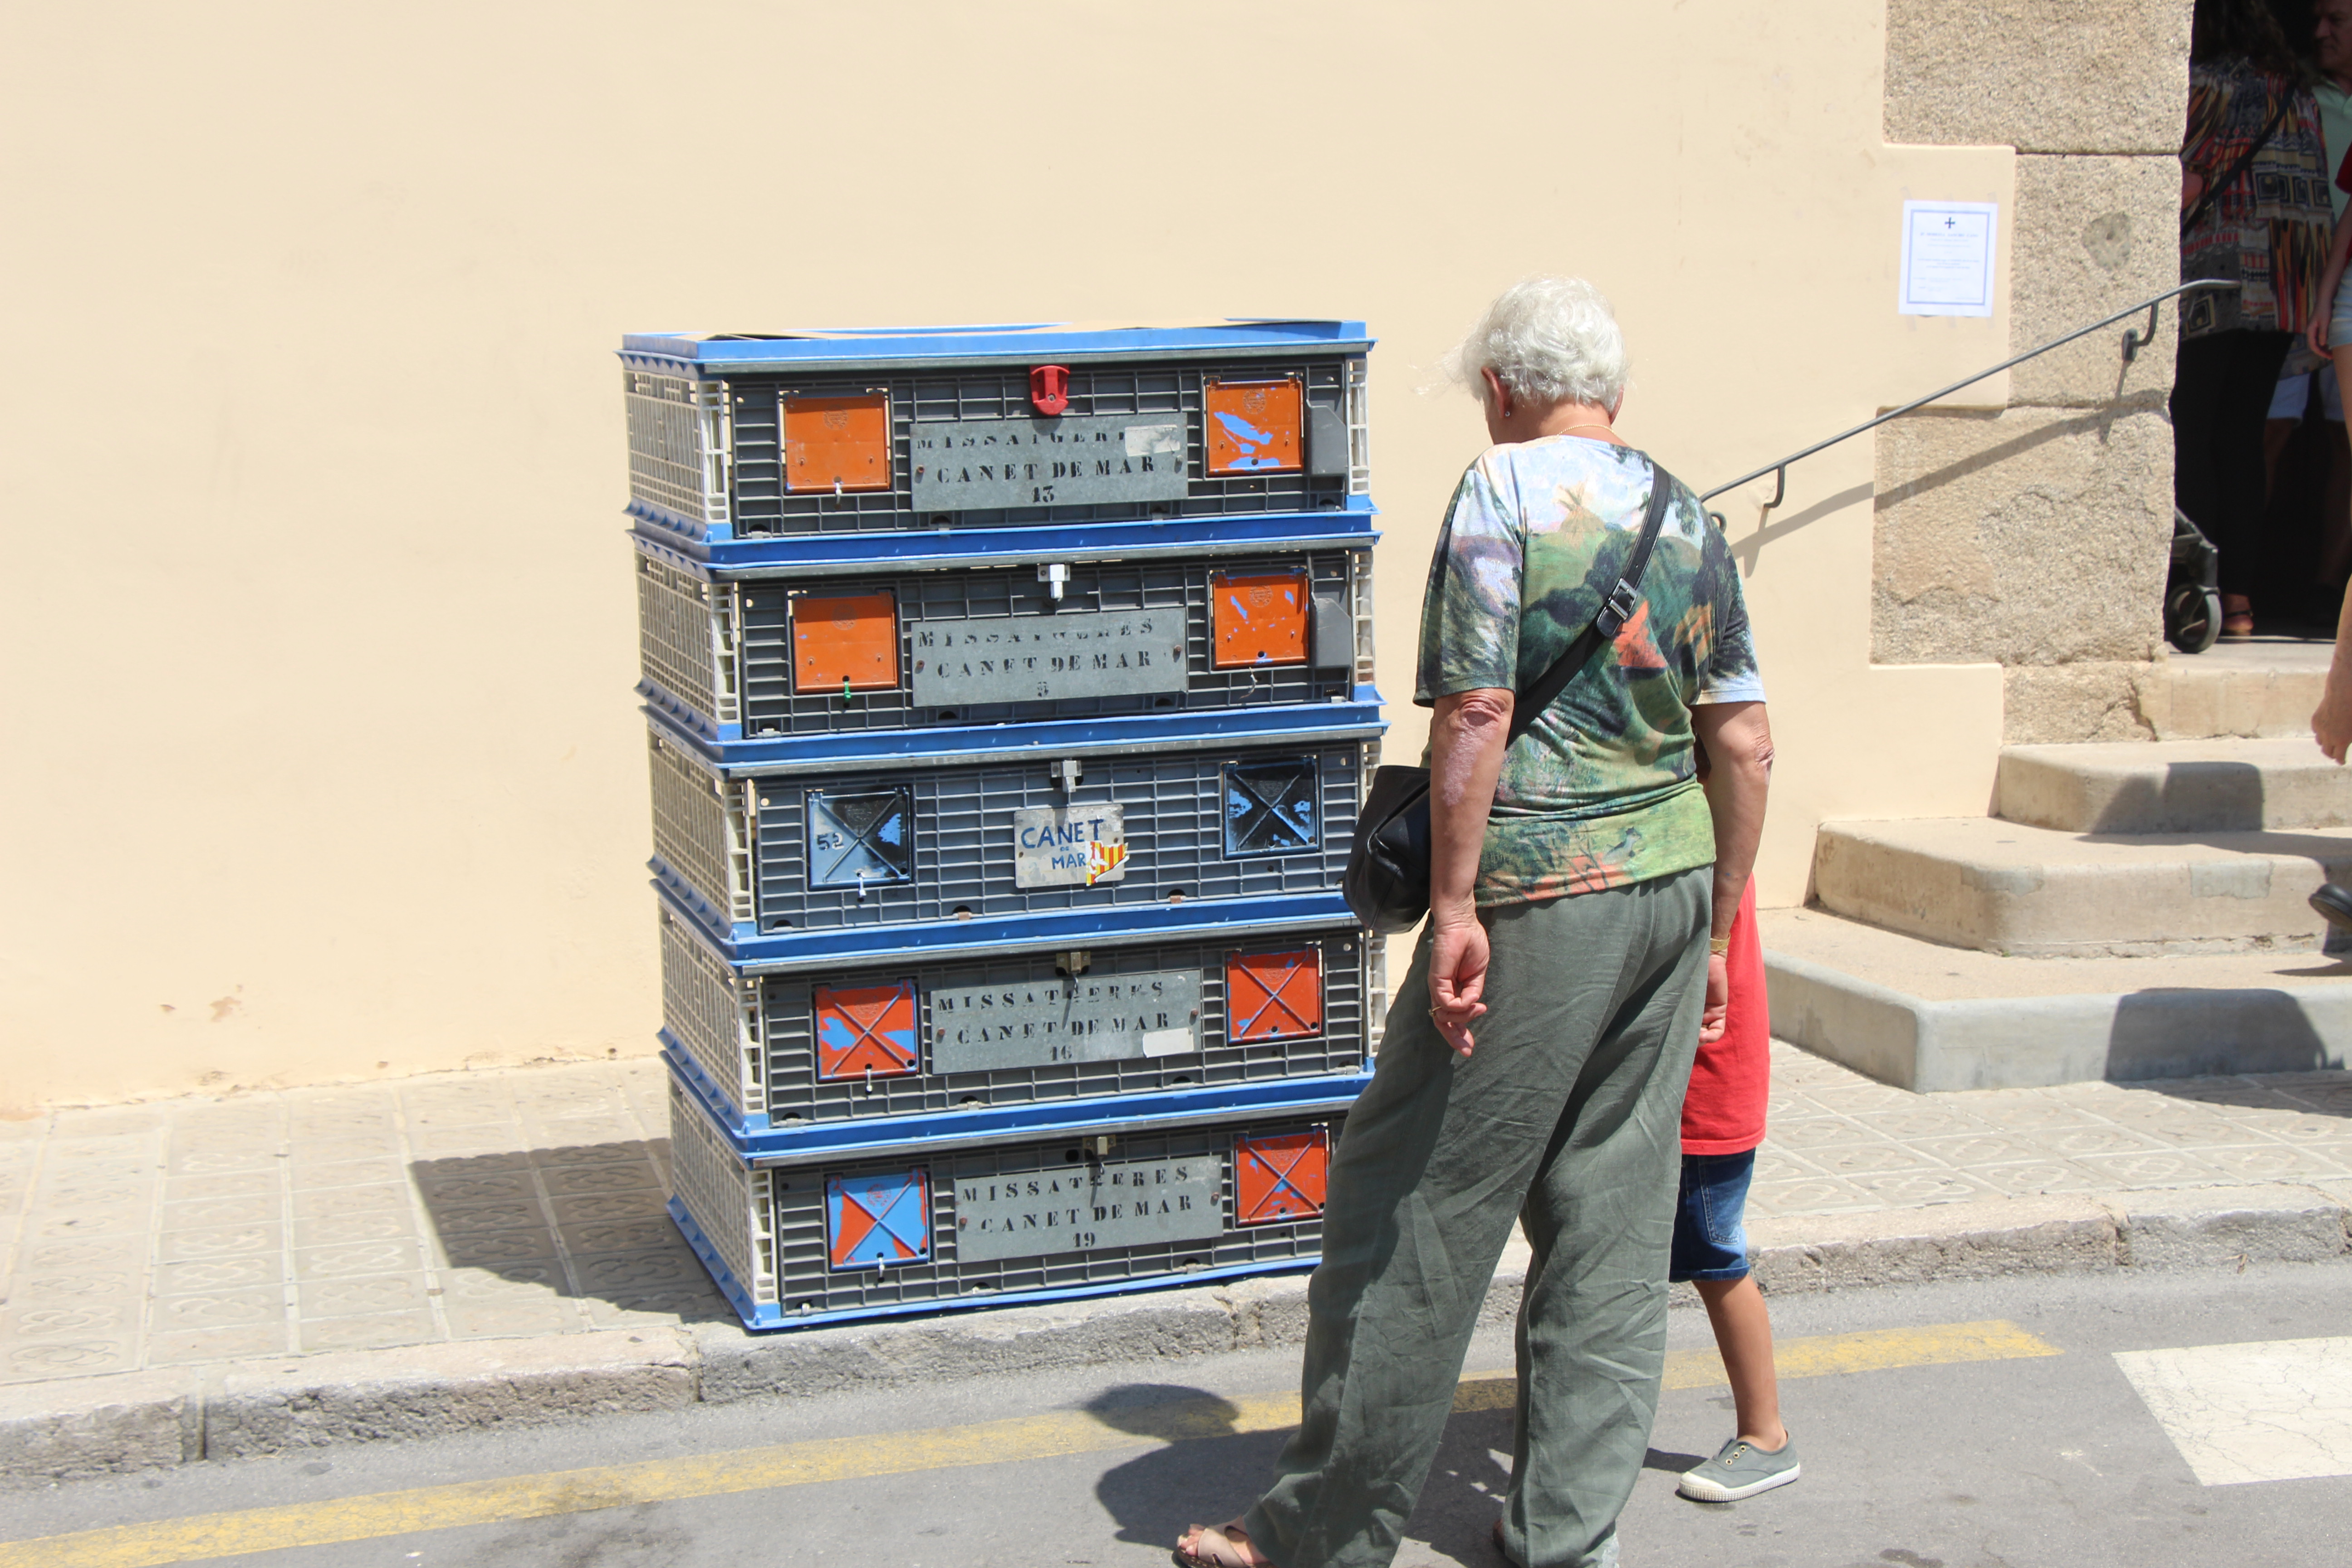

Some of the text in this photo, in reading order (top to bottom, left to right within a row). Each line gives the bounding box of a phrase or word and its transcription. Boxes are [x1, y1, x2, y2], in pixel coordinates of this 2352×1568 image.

[937, 456, 1154, 483] CANET DE MAR
[1051, 655, 1080, 671] DE
[1093, 651, 1150, 669] MAR
[817, 833, 844, 850] 52
[1021, 819, 1104, 848] CANET
[1052, 853, 1086, 870] MAR
[957, 1013, 1168, 1044] CANET DE MAR
[981, 1196, 1191, 1232] CANET DE MAR
[1073, 1232, 1096, 1248] 19
